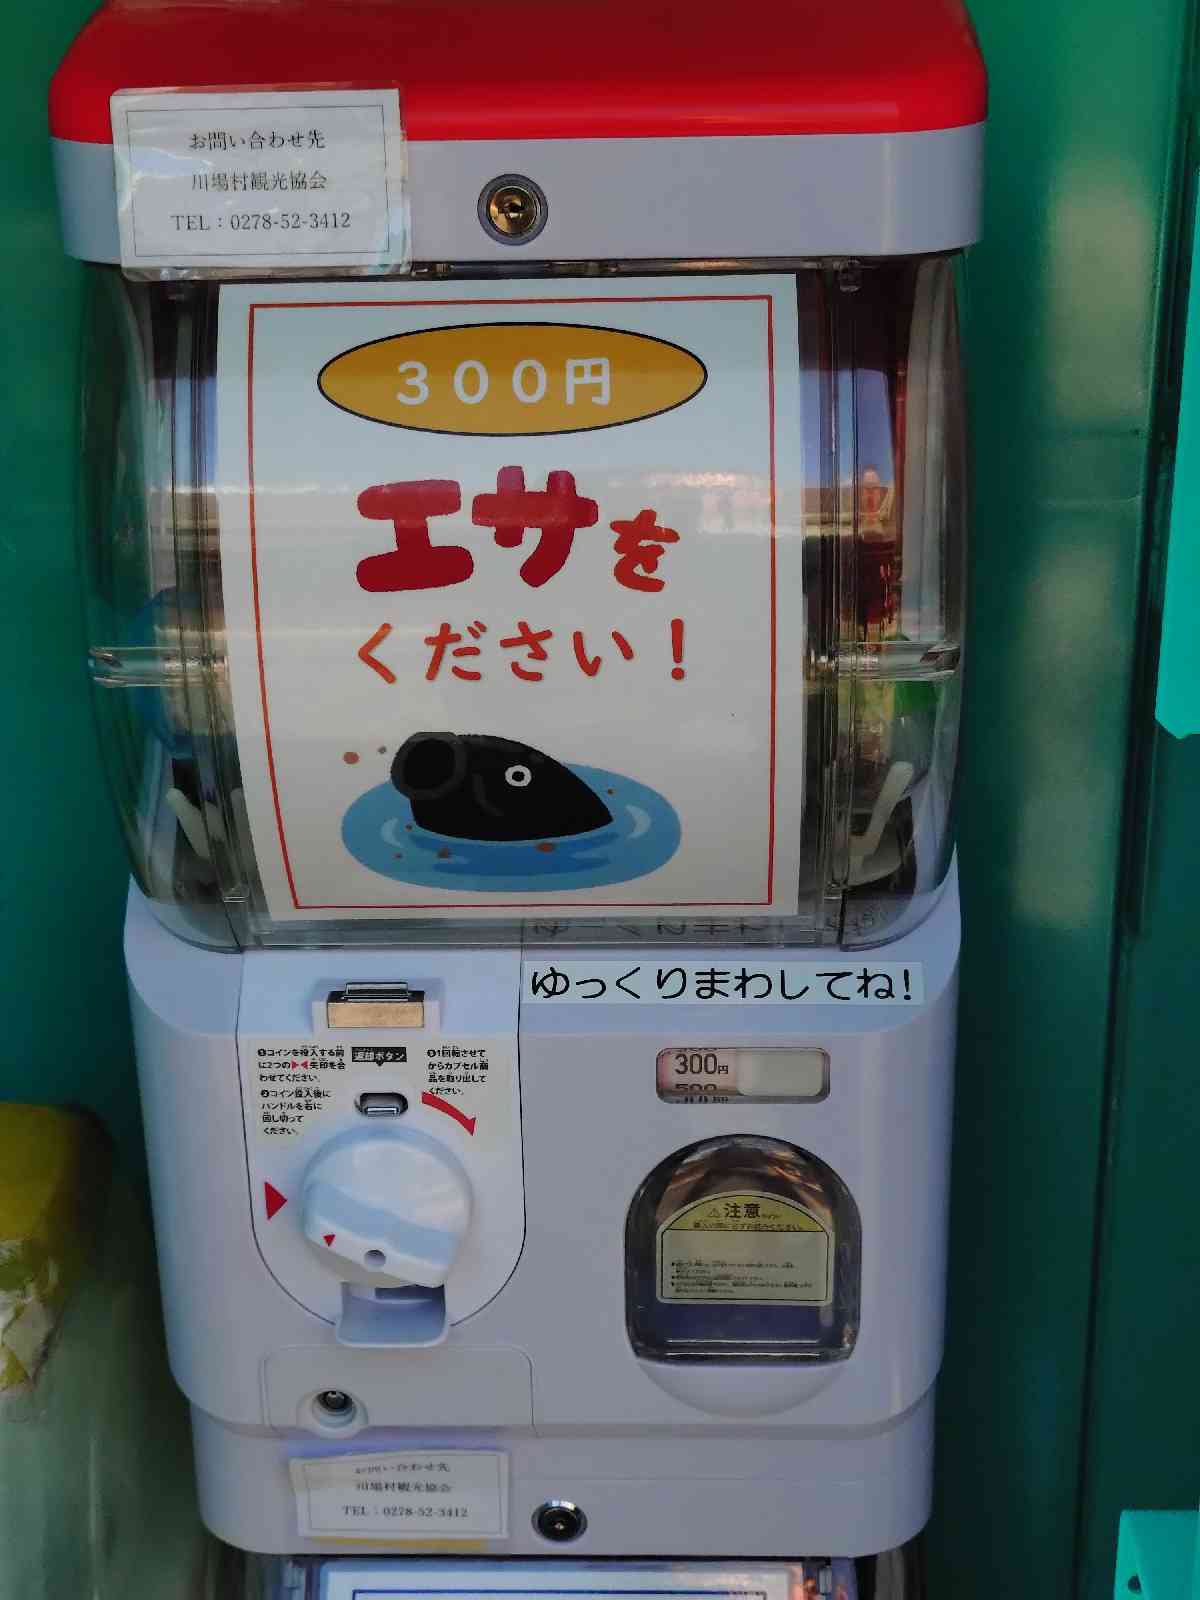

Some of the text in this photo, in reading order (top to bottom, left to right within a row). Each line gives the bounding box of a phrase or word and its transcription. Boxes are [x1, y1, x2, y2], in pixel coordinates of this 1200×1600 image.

[189, 130, 326, 151] お問い合わせ先
[192, 170, 328, 192] 川場村観光協会
[396, 357, 612, 406] 300円
[355, 465, 681, 594] エサを
[674, 1053, 729, 1074] 300円
[724, 1202, 761, 1219] 注意
